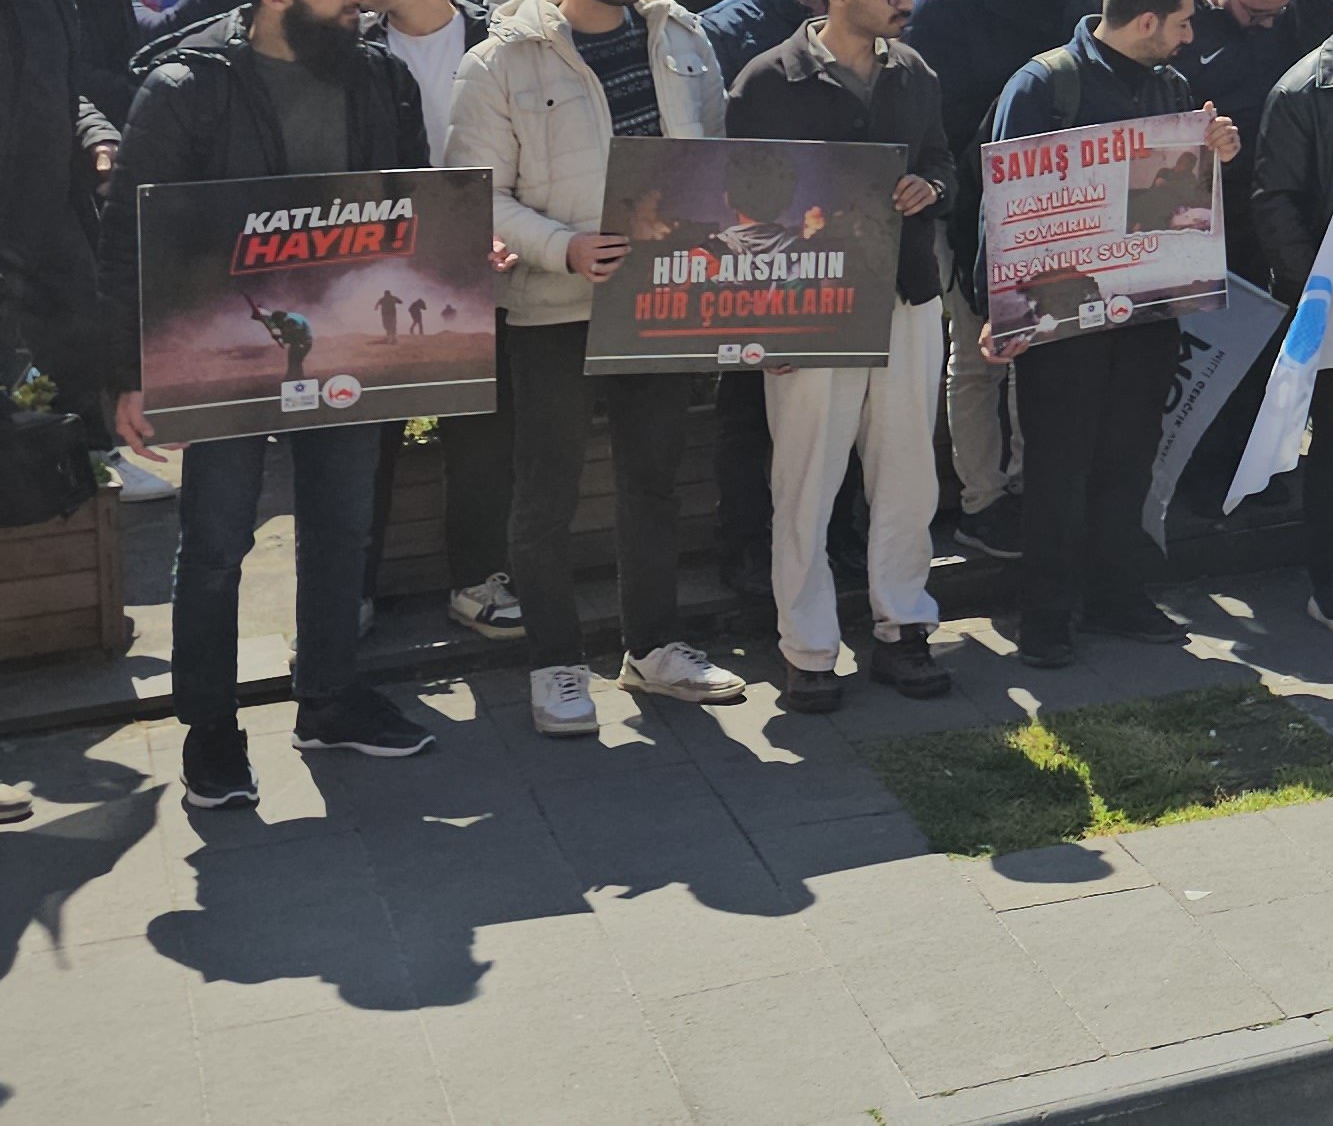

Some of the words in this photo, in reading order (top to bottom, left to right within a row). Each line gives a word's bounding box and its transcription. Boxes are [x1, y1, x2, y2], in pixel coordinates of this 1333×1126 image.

[991, 143, 1069, 184] SAVAŞ
[1080, 127, 1151, 168] DEĞİL
[243, 197, 414, 235] KATLİAMA
[1006, 183, 1106, 218] KATLİAM
[244, 226, 385, 267] HAYIR
[1014, 215, 1101, 244] SOYKIRIM
[652, 250, 708, 285] HÜR
[992, 247, 1093, 285] İNSANLIK
[1097, 233, 1160, 261] SUÇU
[635, 287, 689, 321] HÜR
